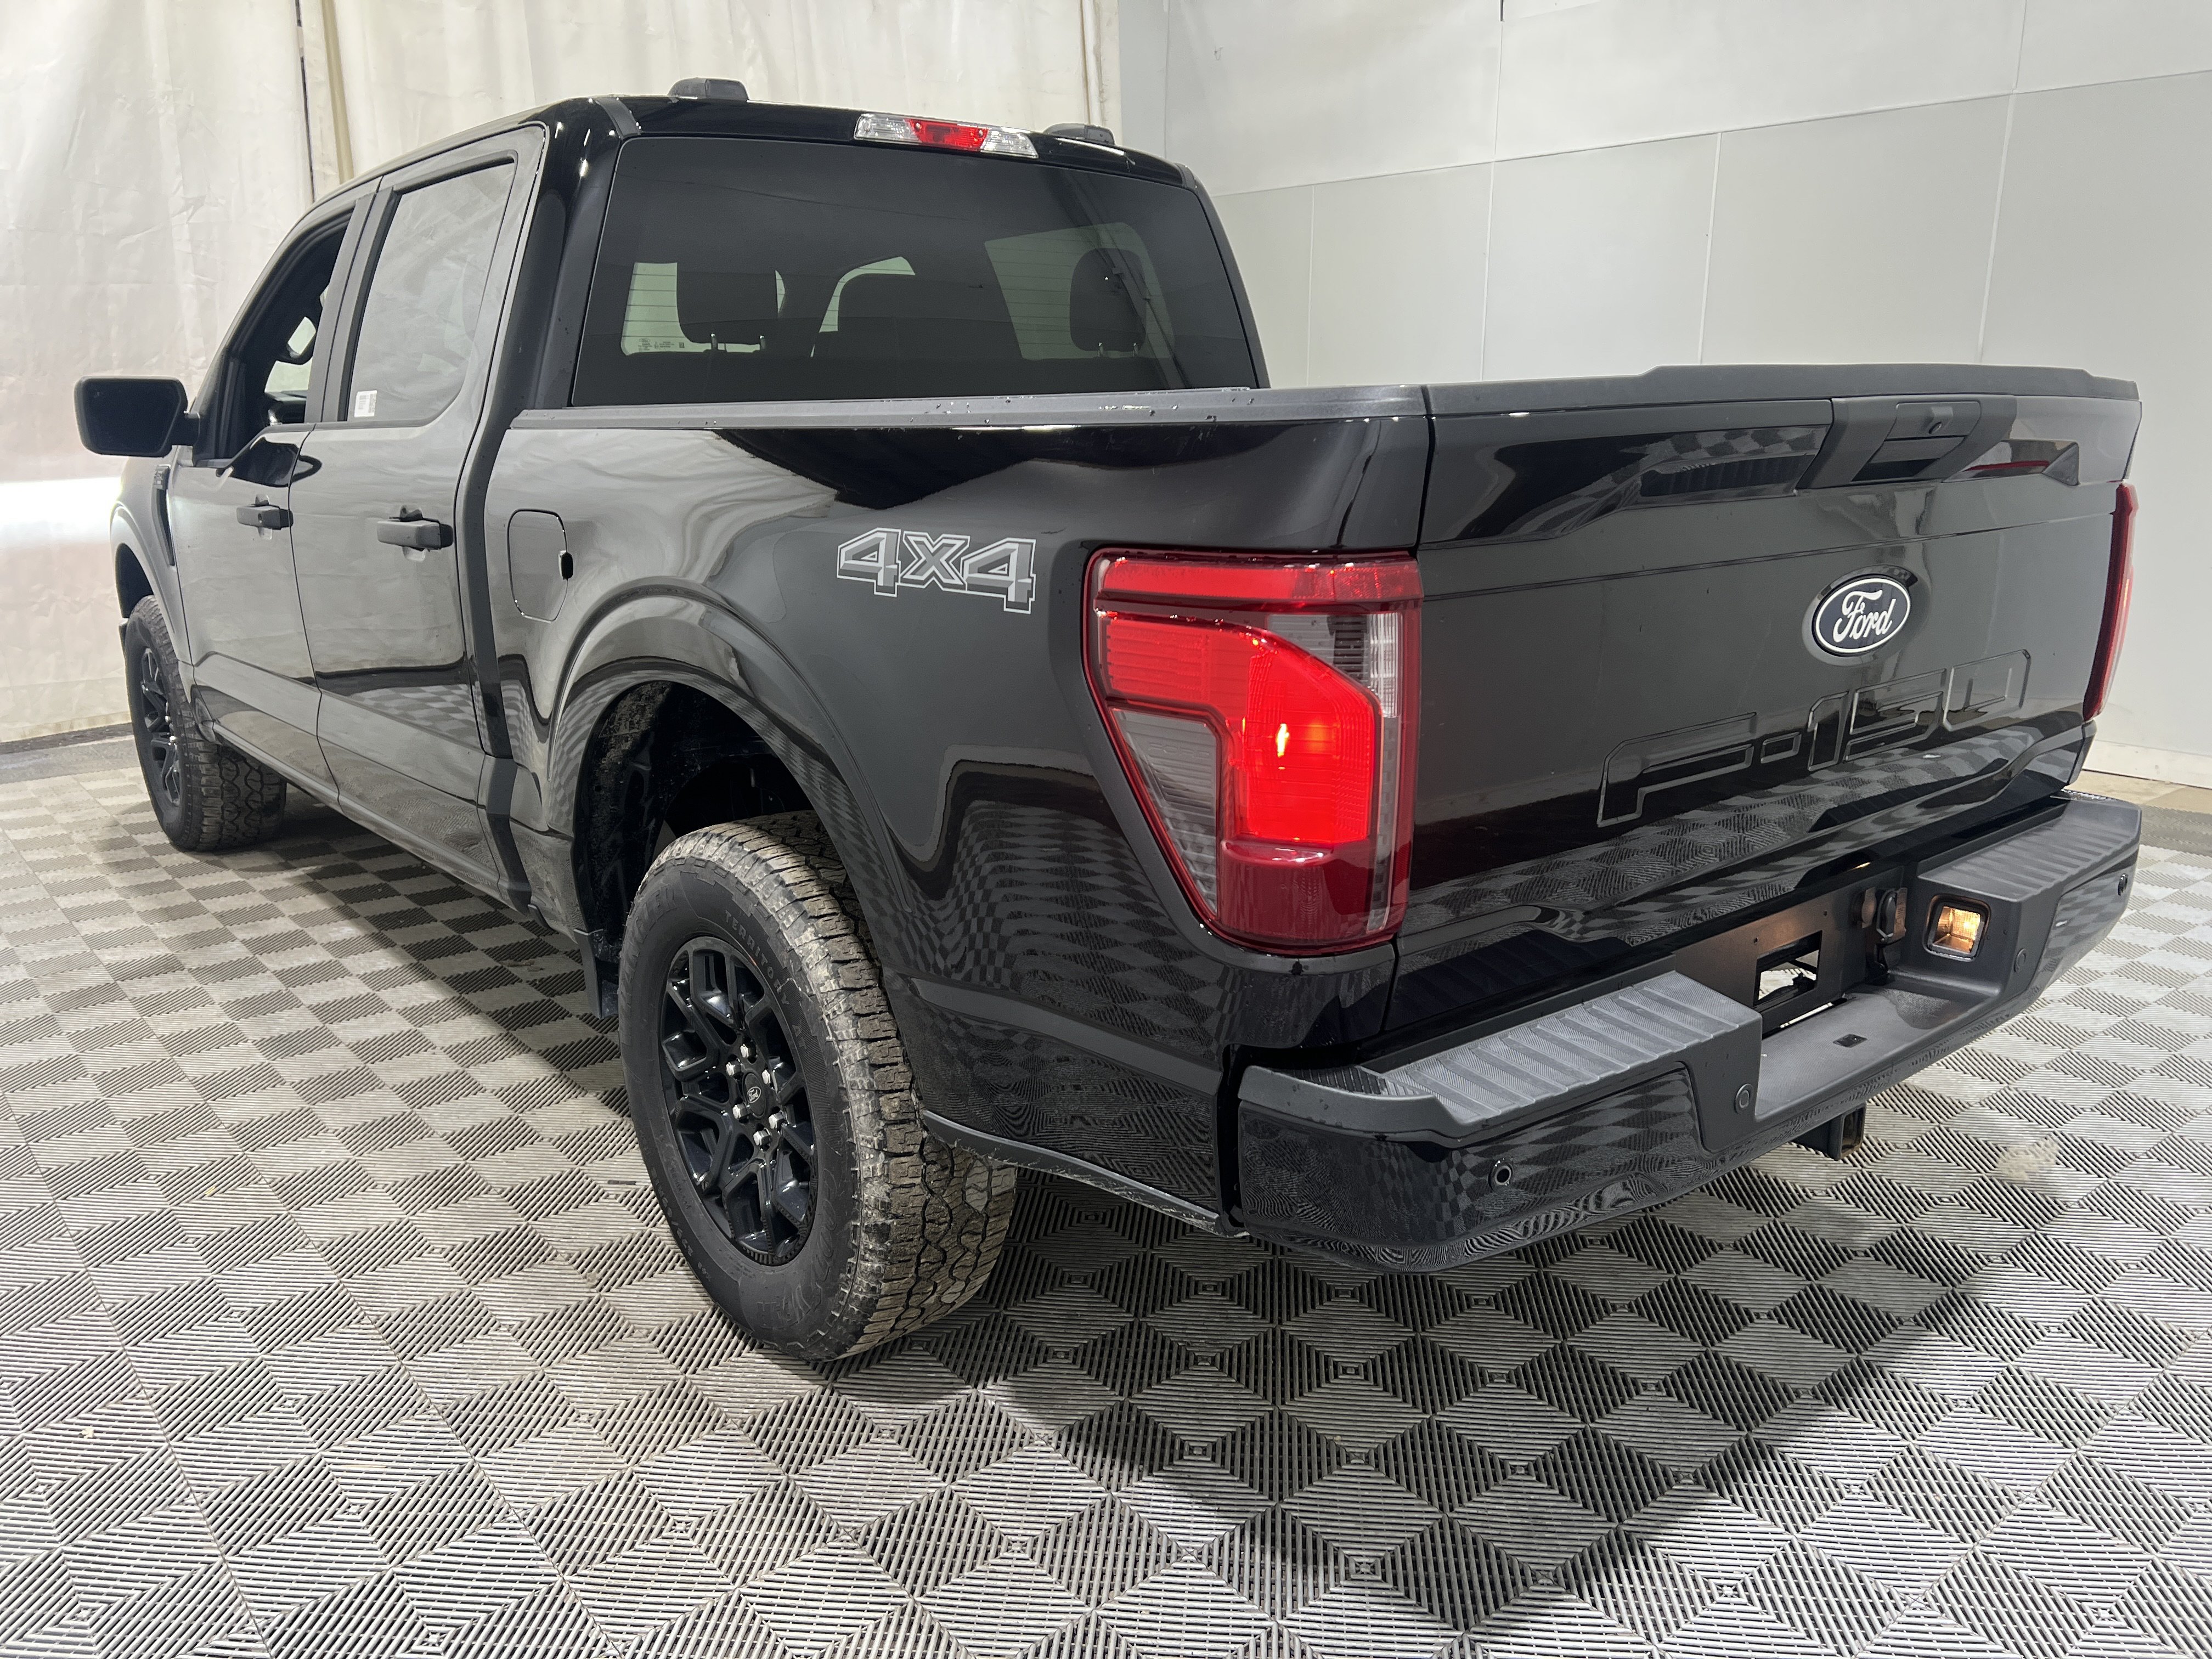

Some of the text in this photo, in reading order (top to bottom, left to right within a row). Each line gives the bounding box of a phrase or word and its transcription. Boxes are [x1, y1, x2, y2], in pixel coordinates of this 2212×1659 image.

[1832, 589, 1897, 642] Ford
[1597, 648, 2032, 827] F-150
[725, 910, 790, 1006] TERRITORY
